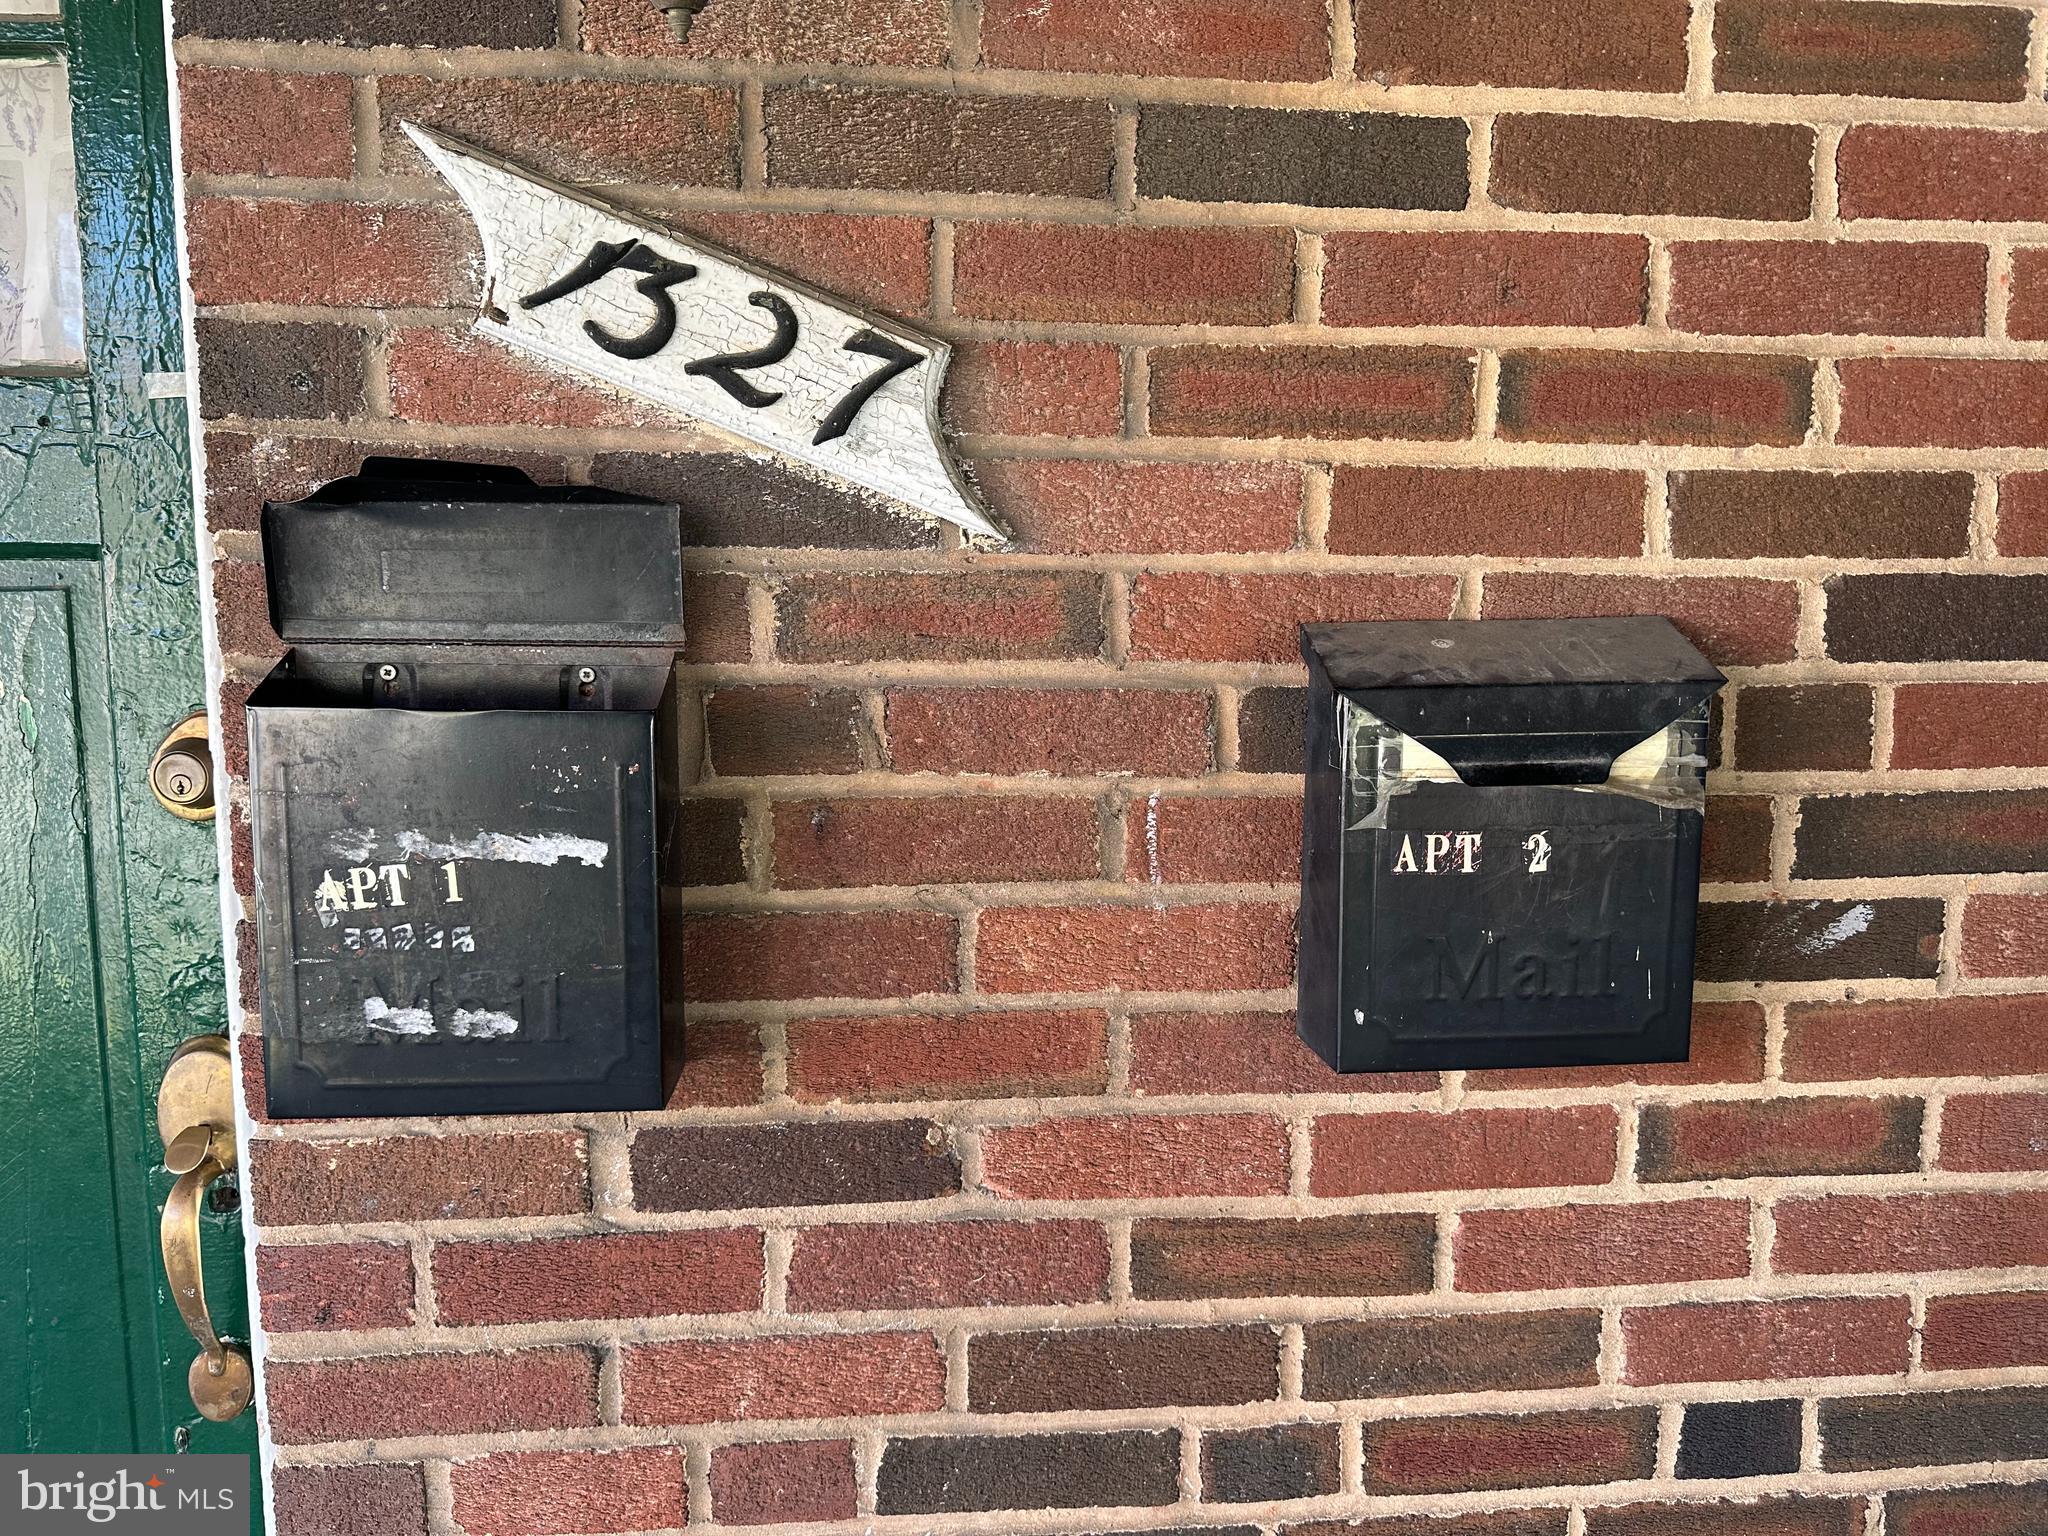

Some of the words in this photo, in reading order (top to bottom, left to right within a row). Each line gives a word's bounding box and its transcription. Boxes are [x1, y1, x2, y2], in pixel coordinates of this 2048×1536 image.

[520, 237, 924, 446] 1327
[1393, 832, 1482, 873] APT
[1523, 830, 1551, 873] 2
[317, 863, 410, 911] APT
[441, 861, 464, 902] 1
[1425, 931, 1618, 1001] Mail
